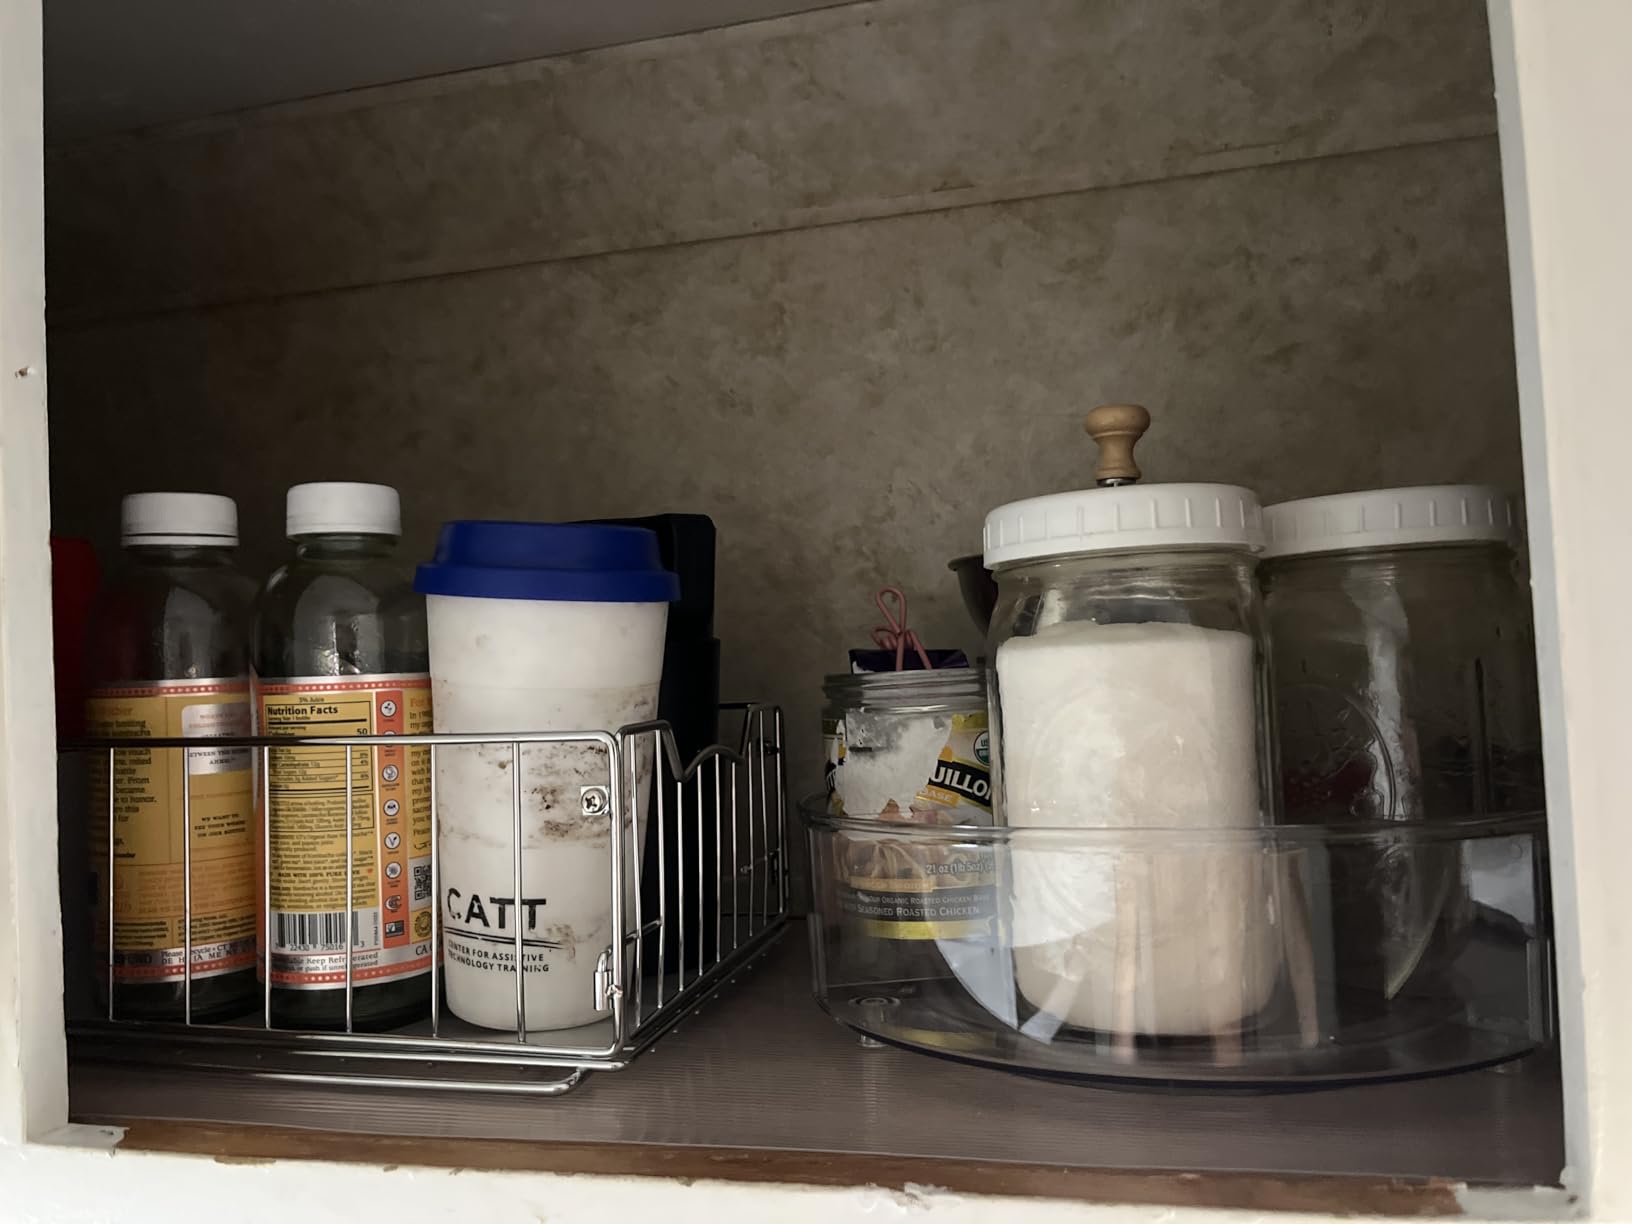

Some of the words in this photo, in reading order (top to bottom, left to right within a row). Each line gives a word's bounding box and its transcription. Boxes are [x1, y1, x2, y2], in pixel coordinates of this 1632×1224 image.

[267, 706, 308, 717] Nutrition
[310, 705, 338, 715] Facts
[931, 766, 990, 804] UILLO
[925, 864, 937, 875] 21
[938, 864, 949, 874] oz
[447, 887, 547, 931] CATT
[857, 904, 894, 917] SEASONED
[896, 906, 937, 918] ROASTED
[939, 905, 980, 917] CHICKEN
[472, 948, 490, 960] FOR
[491, 951, 544, 963] ASSITIVE
[496, 962, 550, 973] TRANING
